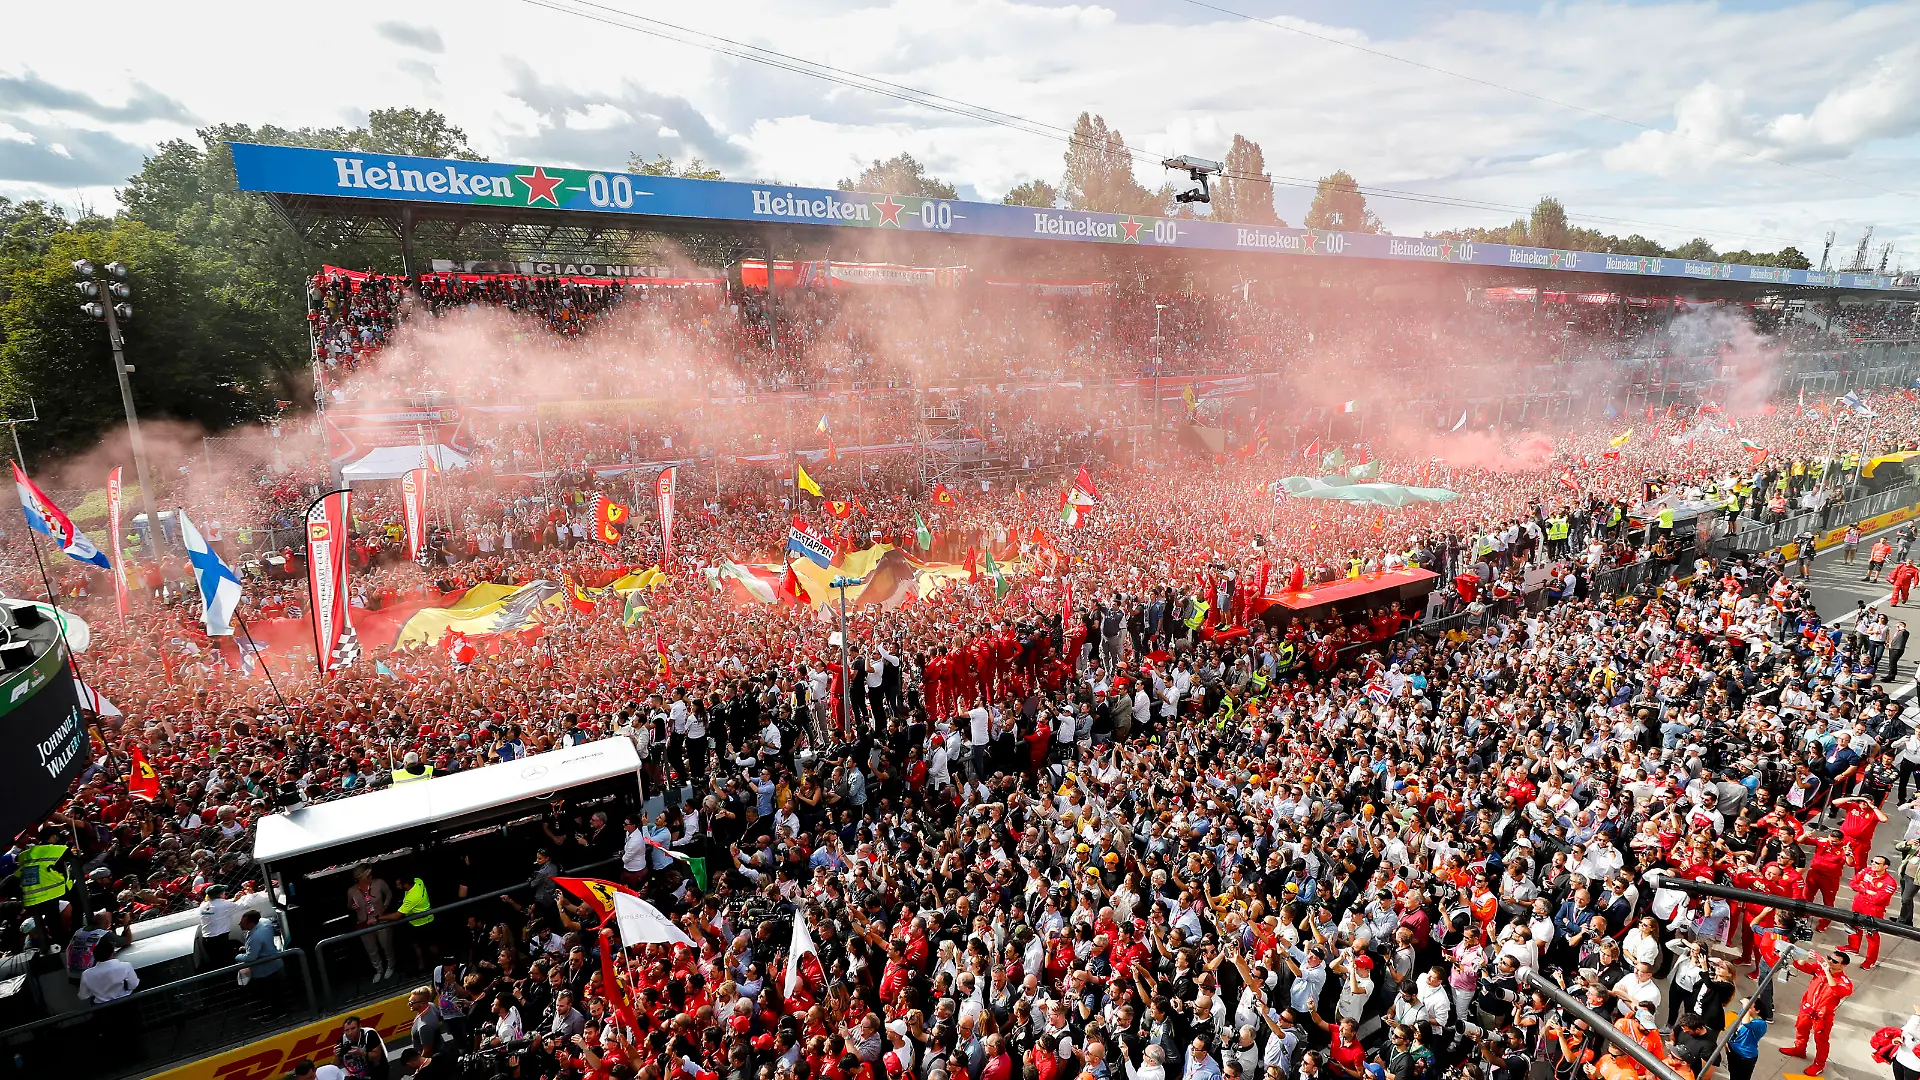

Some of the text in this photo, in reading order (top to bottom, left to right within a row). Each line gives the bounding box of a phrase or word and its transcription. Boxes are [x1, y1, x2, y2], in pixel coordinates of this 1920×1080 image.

[333, 157, 633, 208] Heineken 0.0
[752, 190, 951, 229] Heineken 0.0
[1034, 213, 1176, 244] Heineken 0.0
[1237, 229, 1343, 254] Heineken 0.0
[1390, 239, 1473, 261] Heineken 0.0
[1509, 249, 1548, 264] Heineken
[1606, 257, 1638, 271] Heineken
[1684, 262, 1711, 276] Heineken
[536, 263, 656, 277] CIAO NIKI
[792, 530, 833, 559] VERSTAPPEN
[804, 525, 824, 543] MAX
[36, 715, 74, 767] JOHNNIE
[46, 734, 79, 779] WALKER
